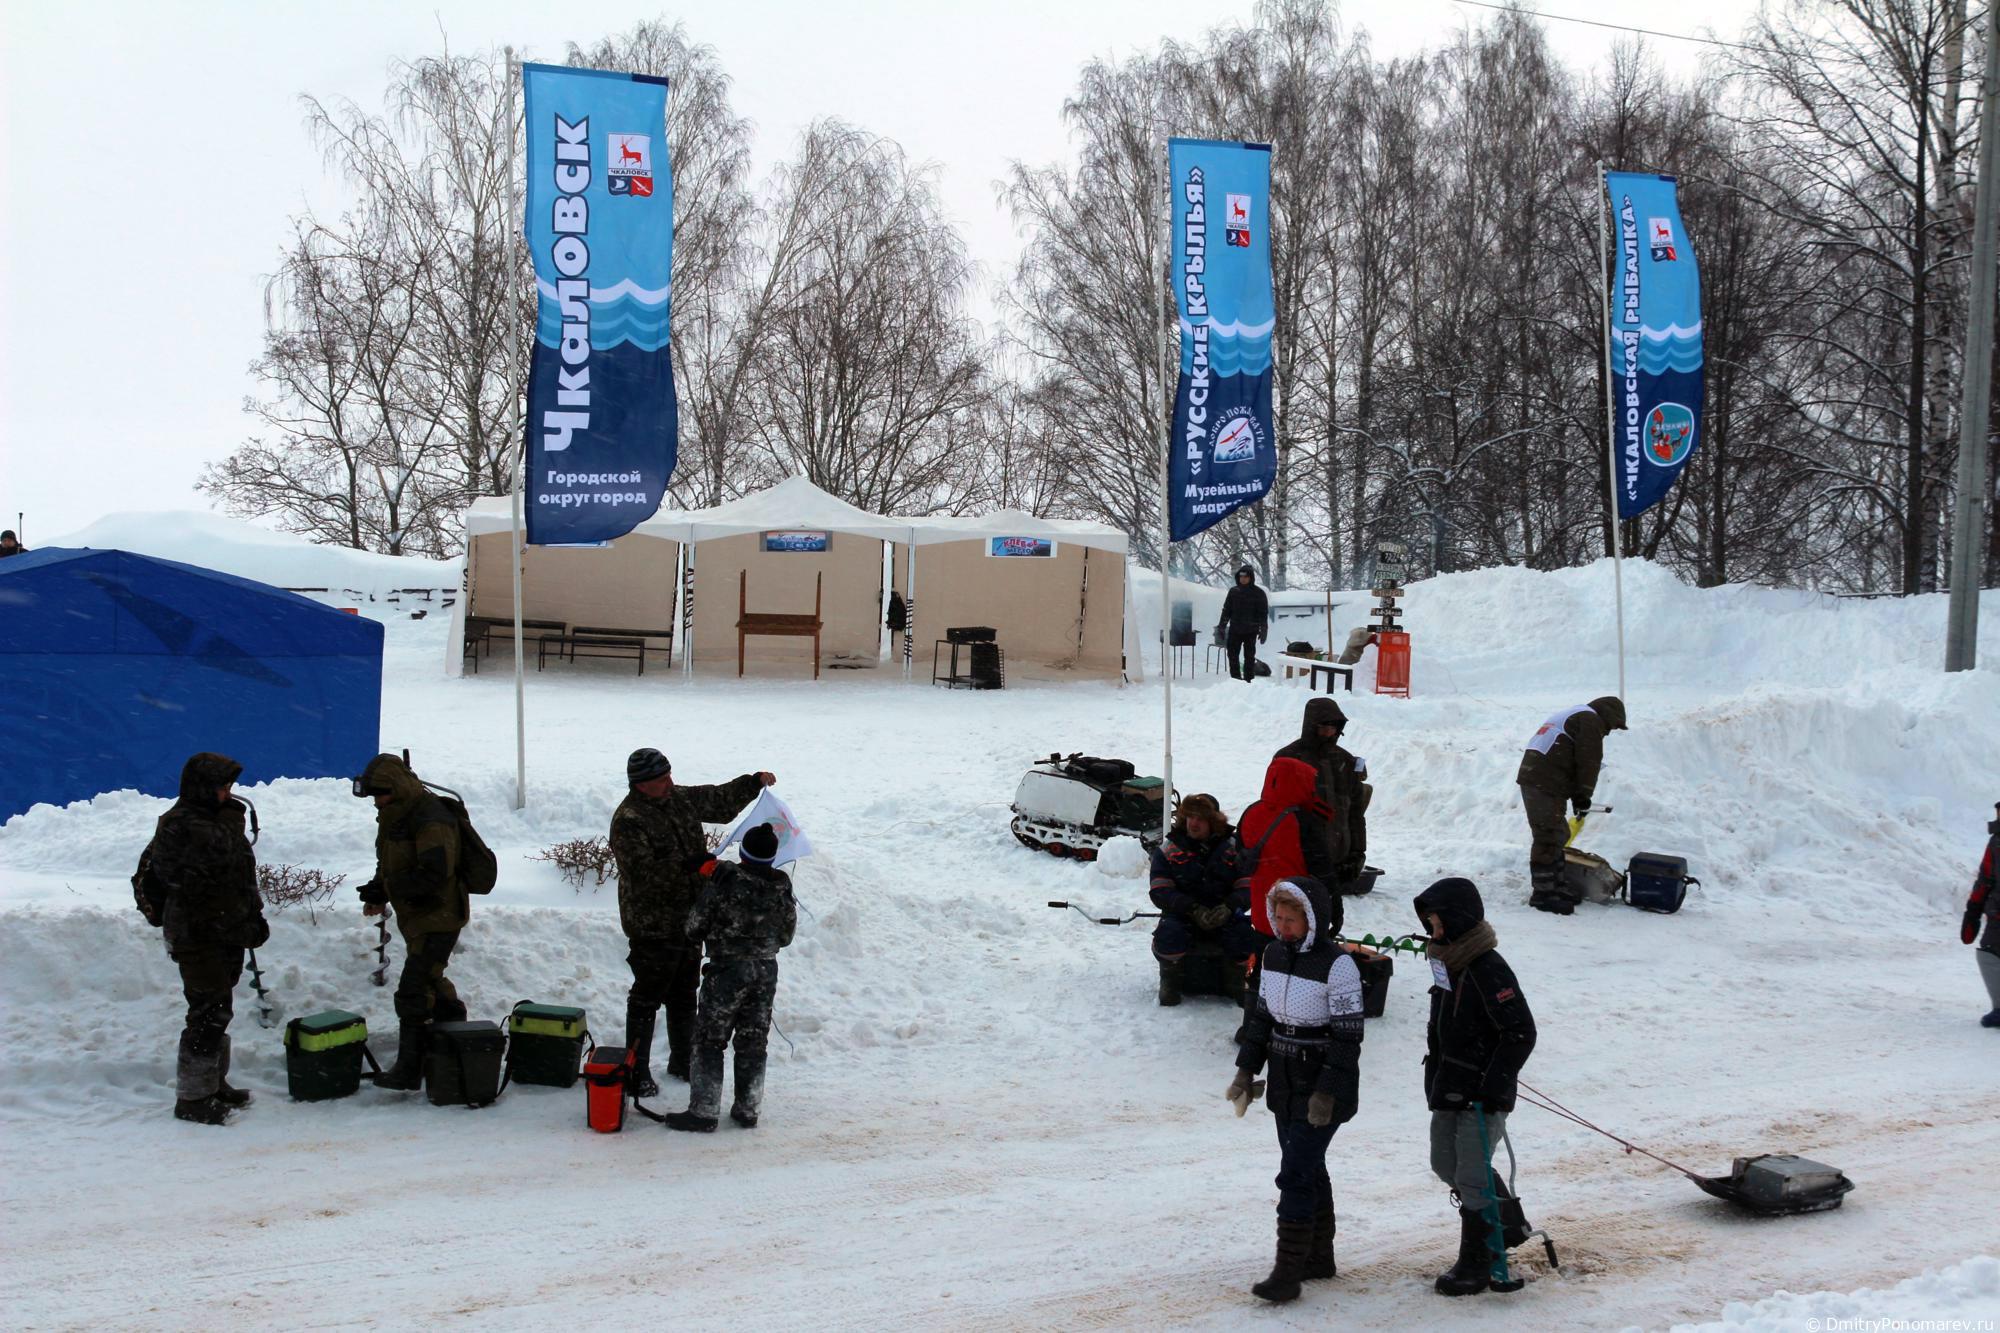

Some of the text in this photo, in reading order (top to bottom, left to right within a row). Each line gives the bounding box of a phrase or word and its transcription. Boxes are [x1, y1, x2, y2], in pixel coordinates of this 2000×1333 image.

[1184, 165, 1210, 476] «РУССКИЕ КРЫЛЬЯ»
[1621, 195, 1641, 501] «ЧКАЛОВСКАЯ РЫБАЛКА»
[547, 470, 641, 487] Городской
[538, 491, 647, 508] округ город
[1184, 479, 1263, 501] Музейный
